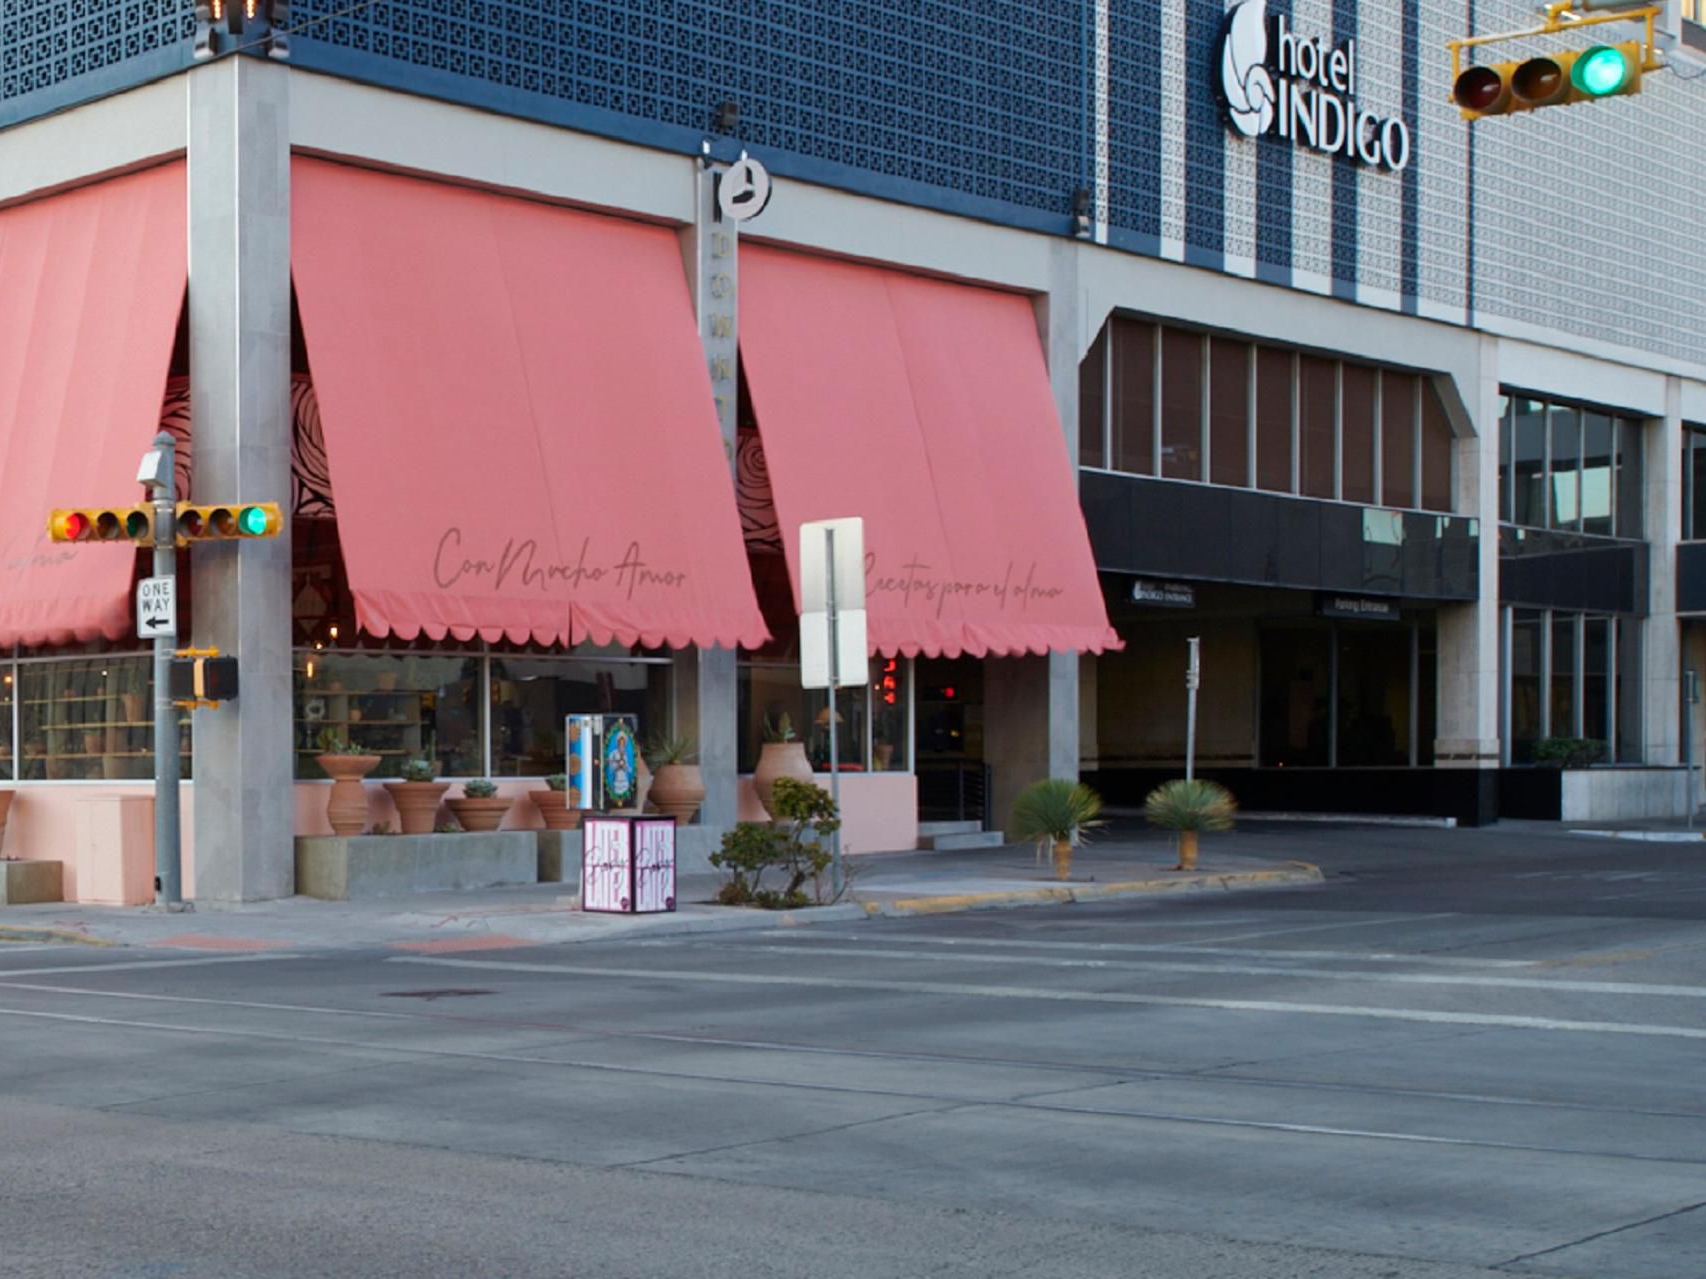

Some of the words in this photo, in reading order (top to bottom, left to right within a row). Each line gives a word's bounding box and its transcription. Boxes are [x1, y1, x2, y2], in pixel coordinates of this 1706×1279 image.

[1278, 14, 1354, 95] hotel
[1278, 78, 1409, 171] INDIGO
[142, 581, 171, 597] ONE
[433, 527, 497, 589] Con
[494, 536, 607, 592] Mucho
[613, 540, 686, 602] Amor
[1012, 560, 1065, 612] alma
[142, 597, 170, 613] WAY
